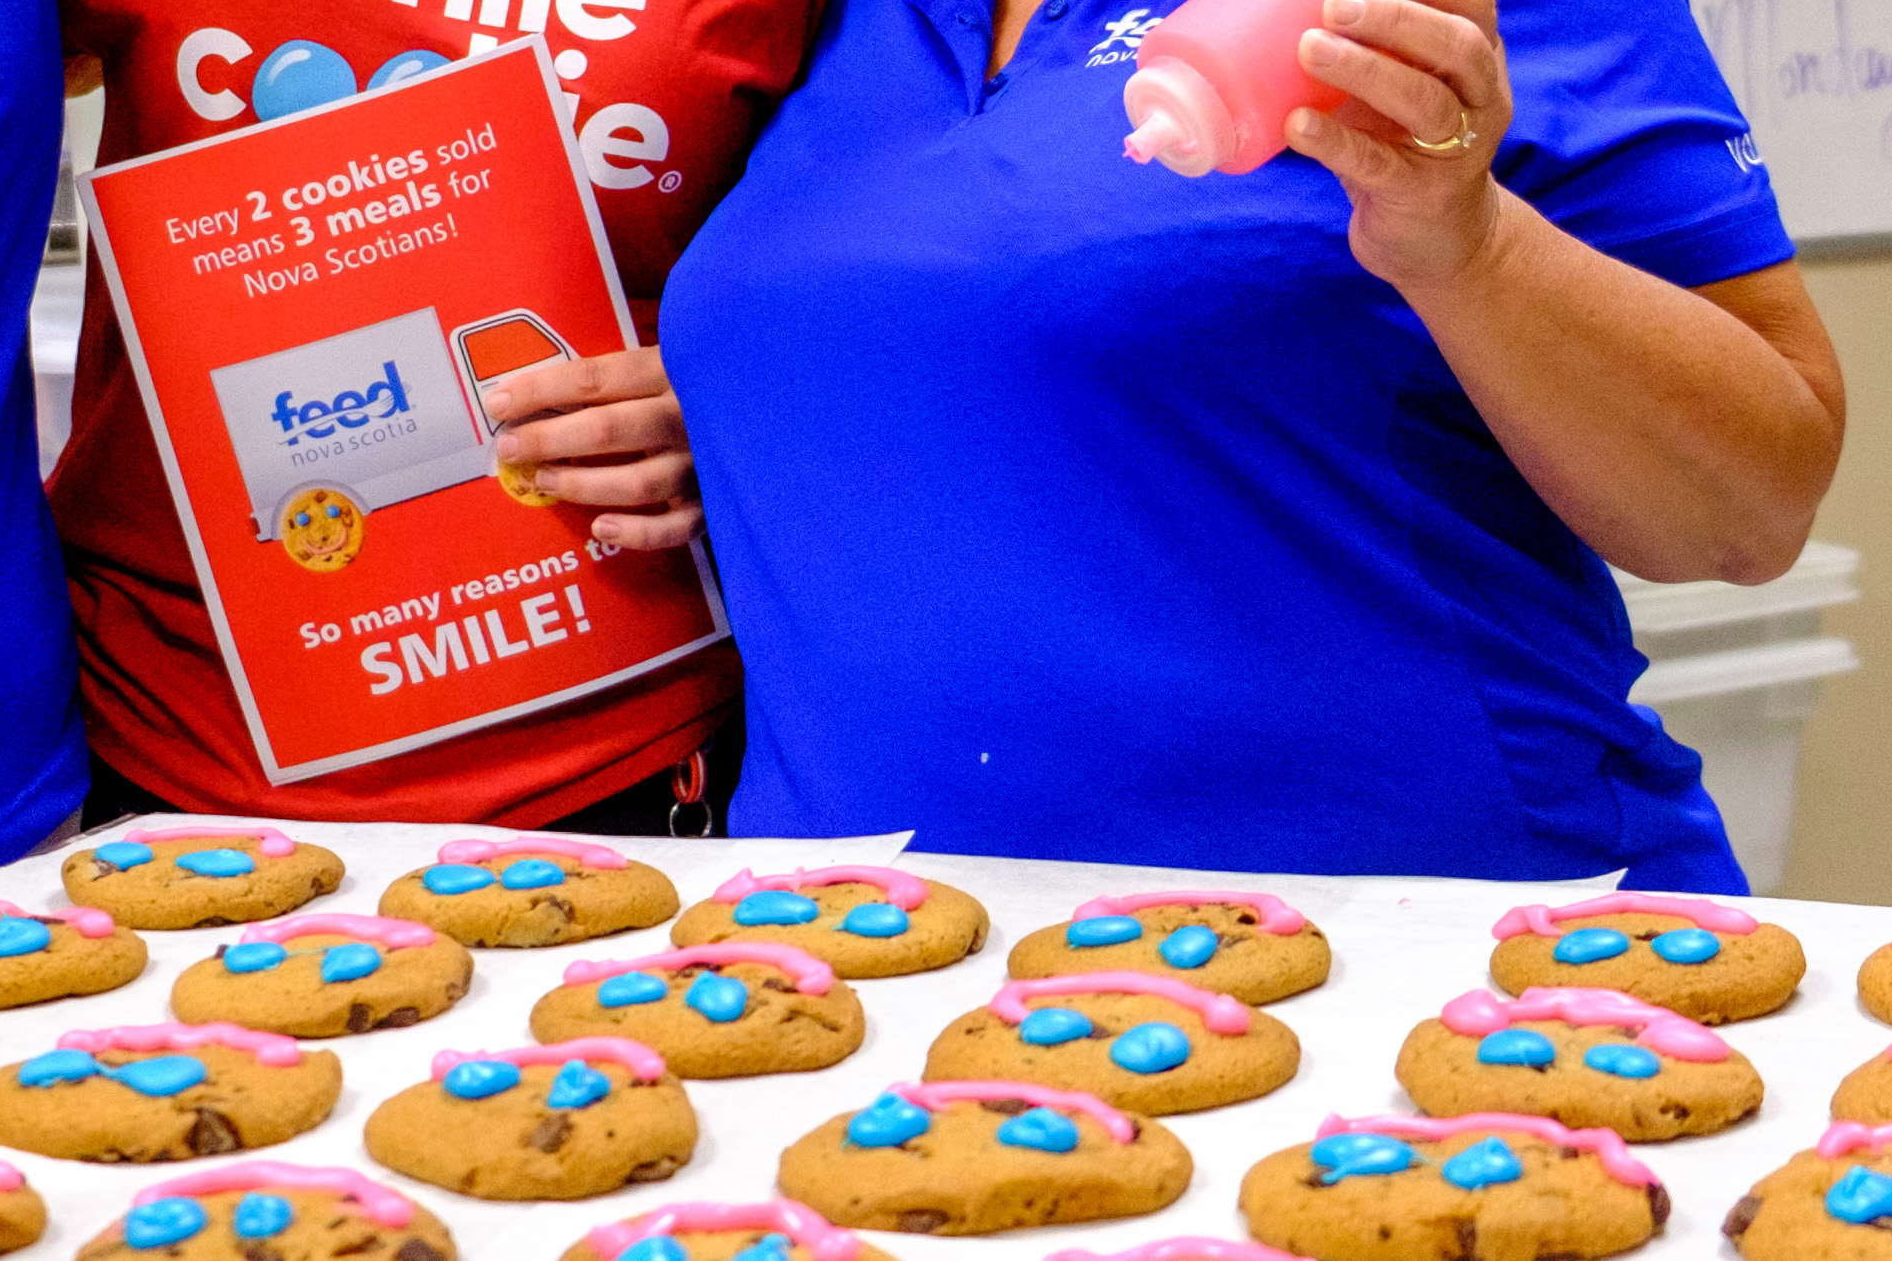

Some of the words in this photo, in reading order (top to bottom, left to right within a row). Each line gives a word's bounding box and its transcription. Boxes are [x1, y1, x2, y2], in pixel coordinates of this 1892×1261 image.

[165, 207, 239, 245] Every
[246, 190, 272, 222] 2
[281, 148, 429, 212] cookies
[436, 122, 497, 166] sold
[192, 232, 285, 275] means
[291, 216, 315, 246] 3
[326, 180, 442, 237] meals
[448, 167, 492, 199] for
[243, 259, 319, 298] Nova
[325, 213, 459, 274] Scotians!
[272, 360, 410, 446] feed
[291, 440, 345, 467] nova
[349, 416, 417, 452] scotia
[299, 621, 341, 649] So
[350, 590, 440, 636] many
[450, 549, 579, 605] reasons
[360, 584, 591, 695] SMILE!
